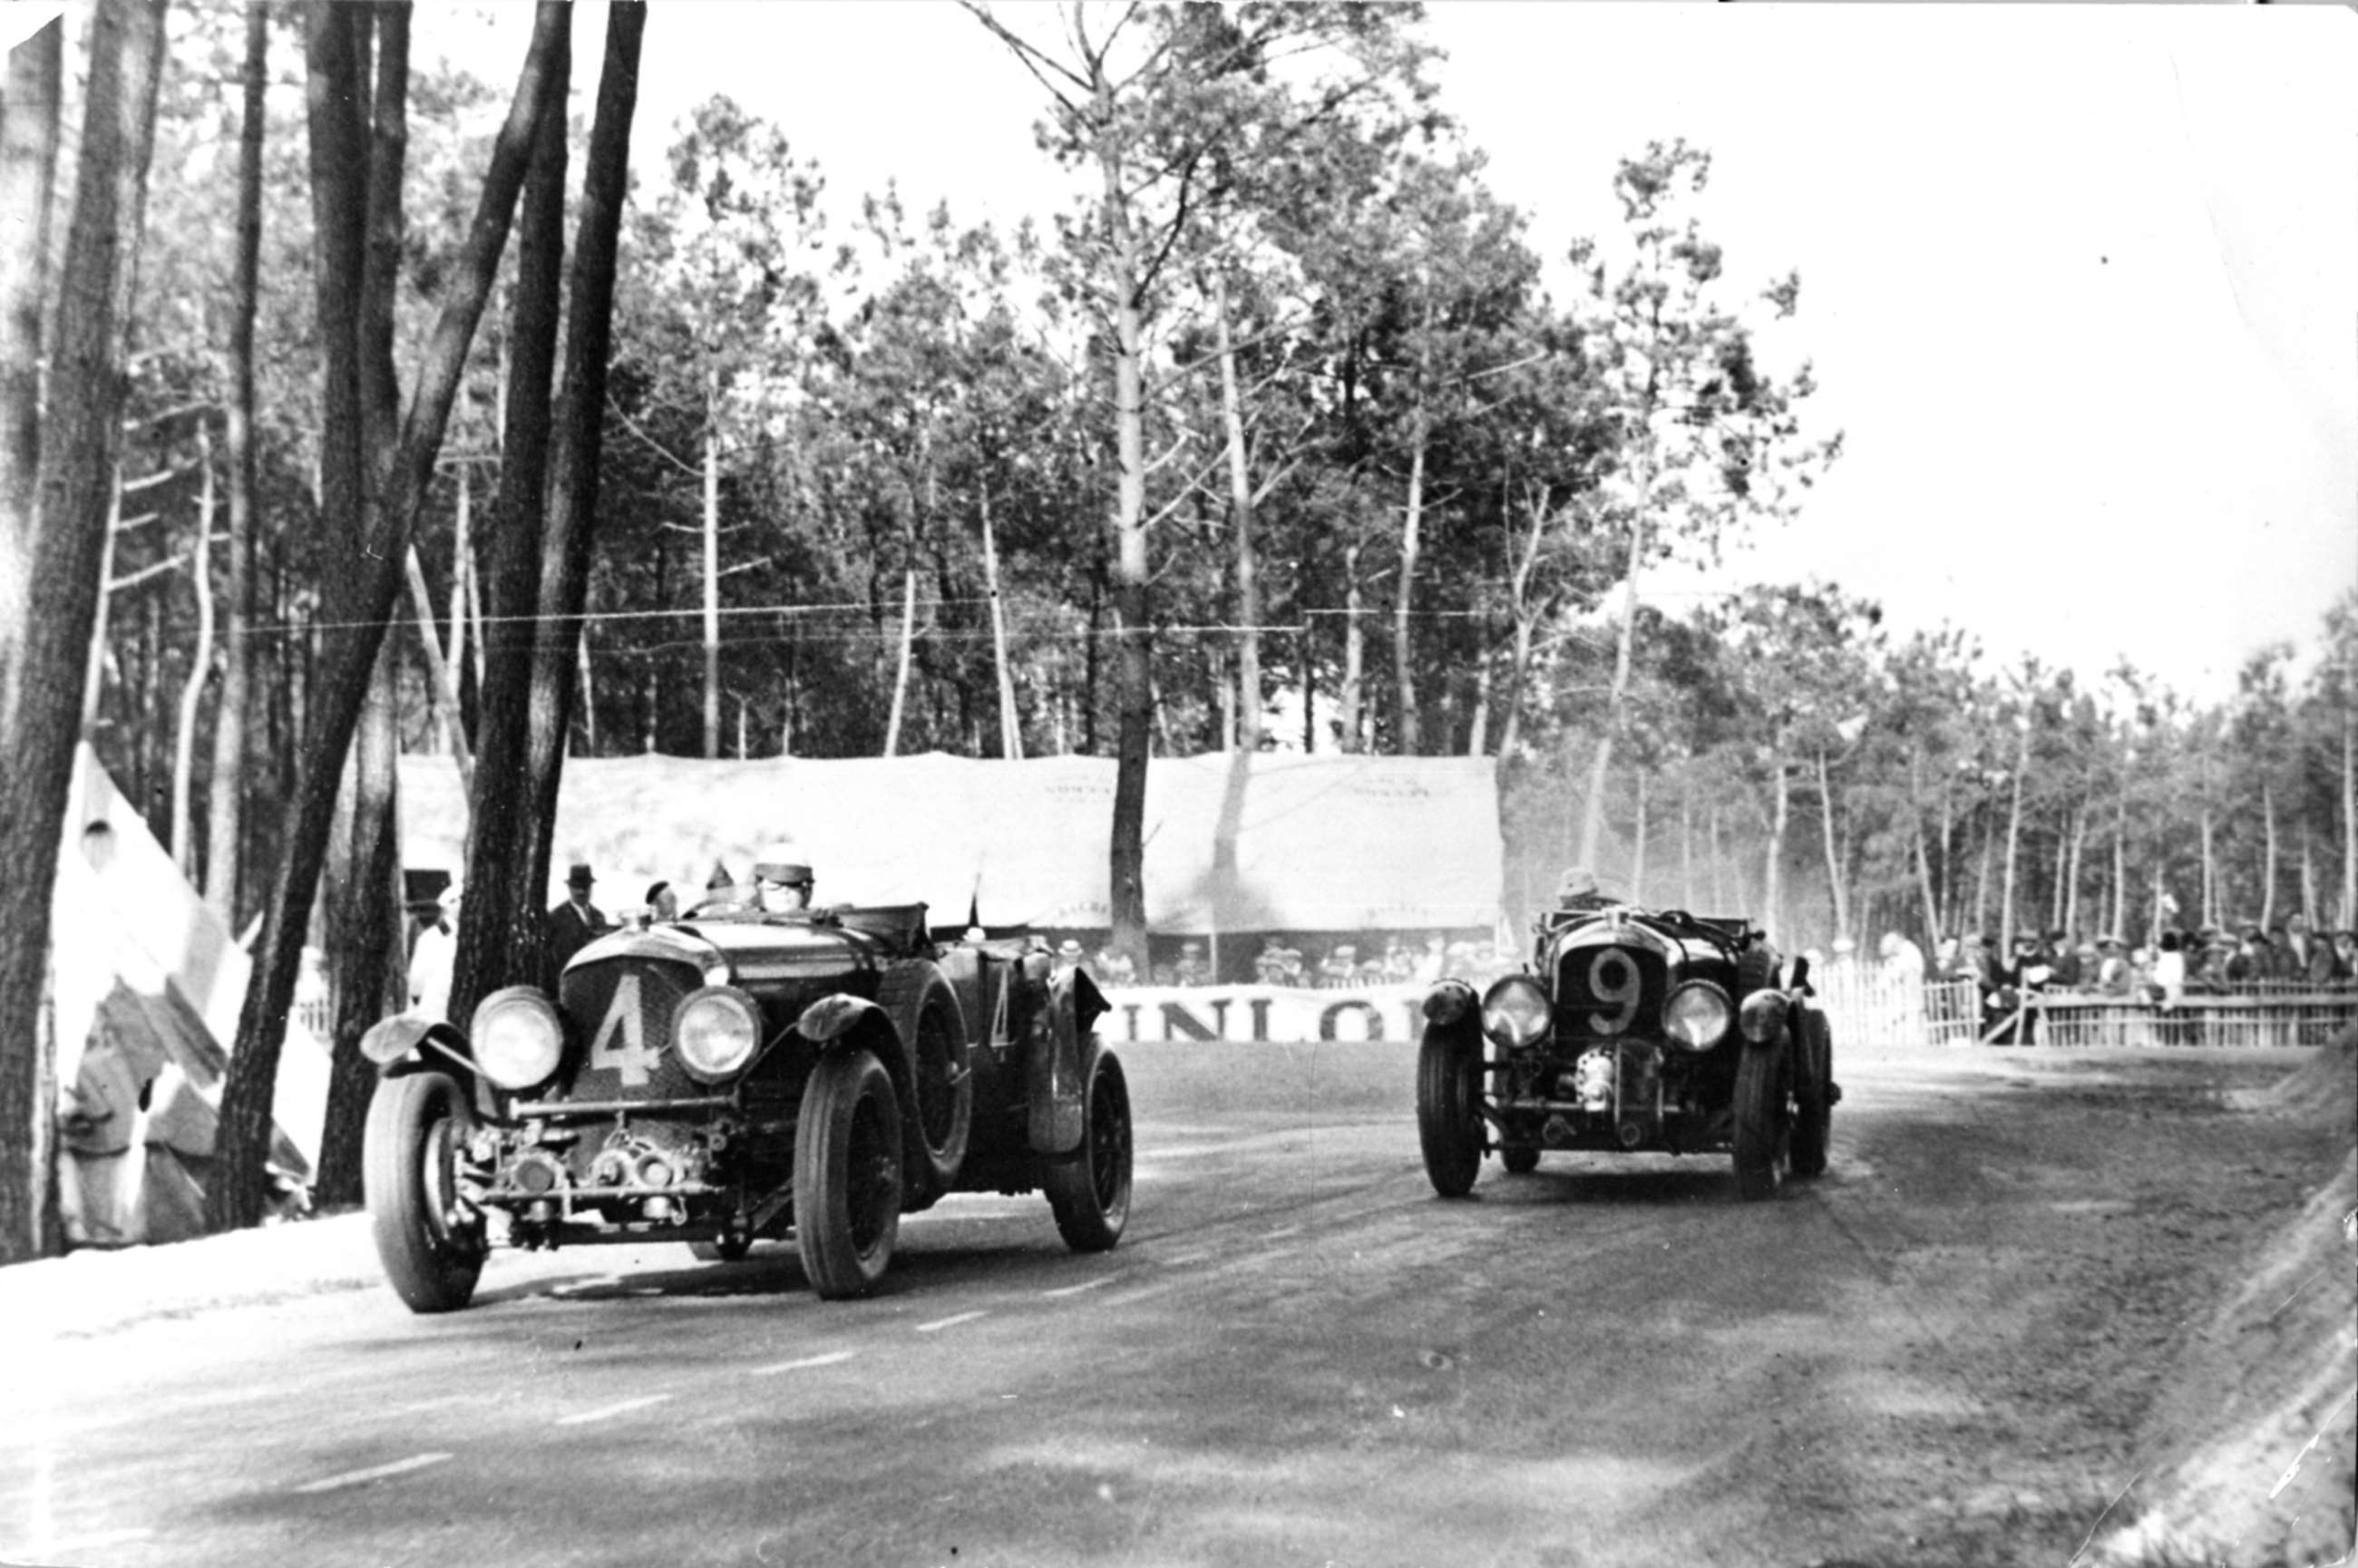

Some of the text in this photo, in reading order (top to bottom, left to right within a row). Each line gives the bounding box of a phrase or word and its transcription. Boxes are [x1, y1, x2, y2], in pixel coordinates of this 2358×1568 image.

[591, 974, 661, 1086] 4
[989, 964, 1016, 1062] 4
[1589, 948, 1641, 1035] 9
